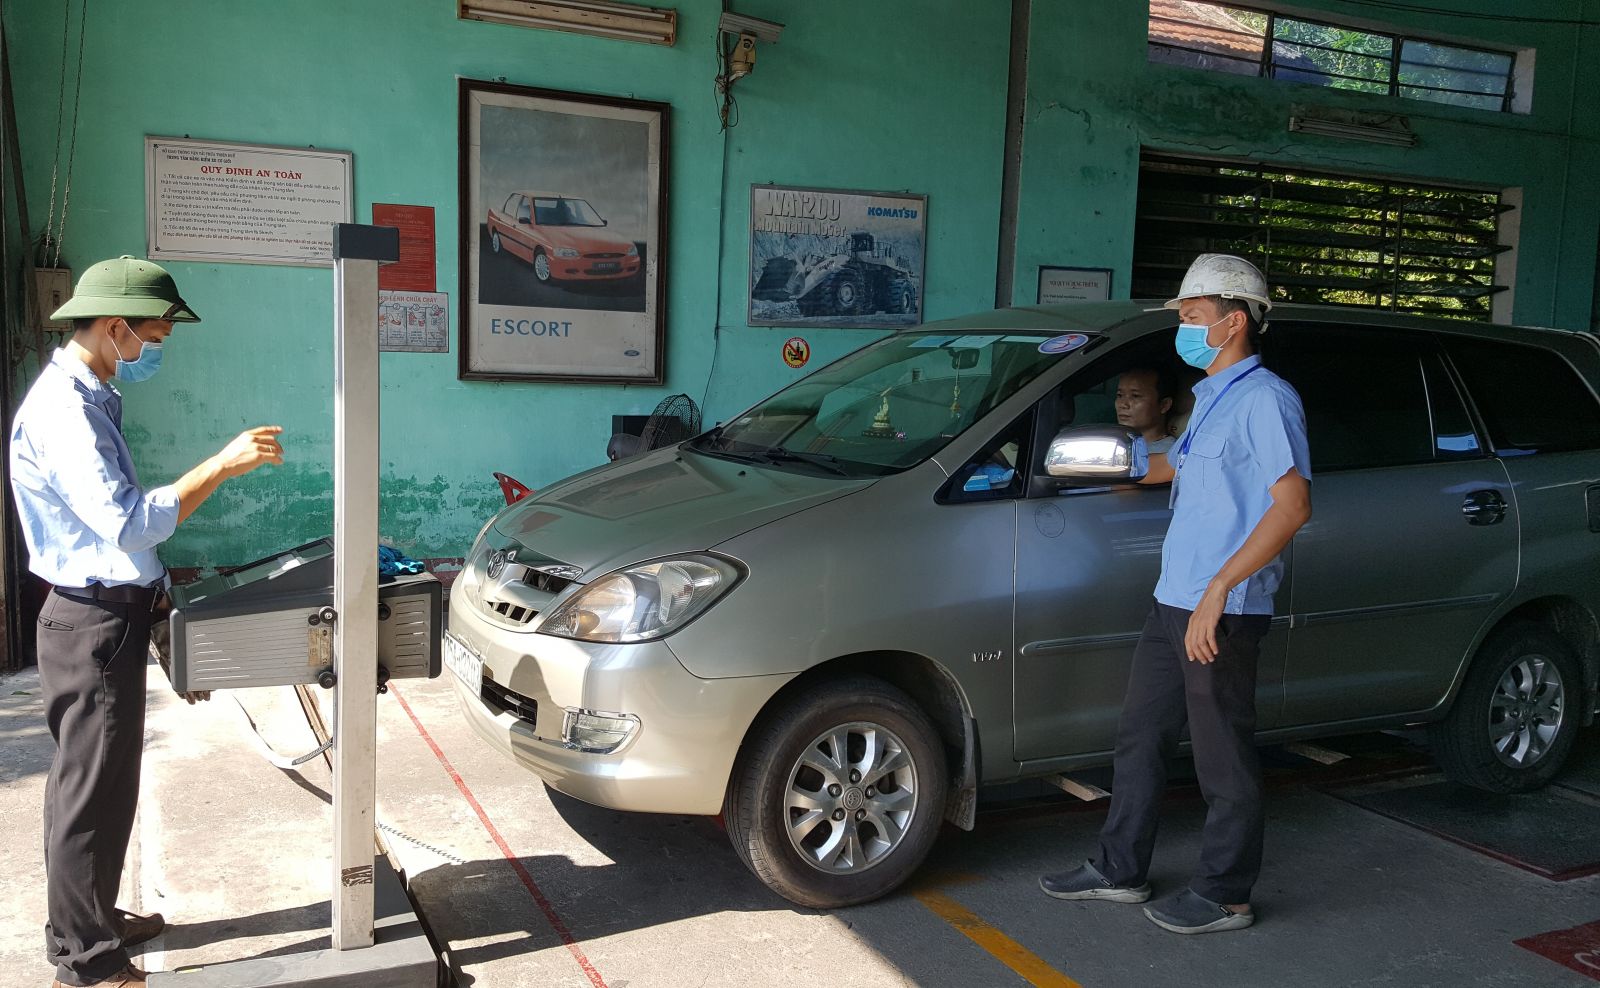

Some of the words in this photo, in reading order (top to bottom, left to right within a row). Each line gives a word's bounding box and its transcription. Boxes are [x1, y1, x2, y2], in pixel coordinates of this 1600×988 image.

[201, 166, 222, 174] QUY
[226, 167, 252, 176] ĐỊNH
[274, 170, 302, 180] TOÀN
[867, 206, 917, 219] KOMATSU
[491, 318, 572, 337] ESCORT
